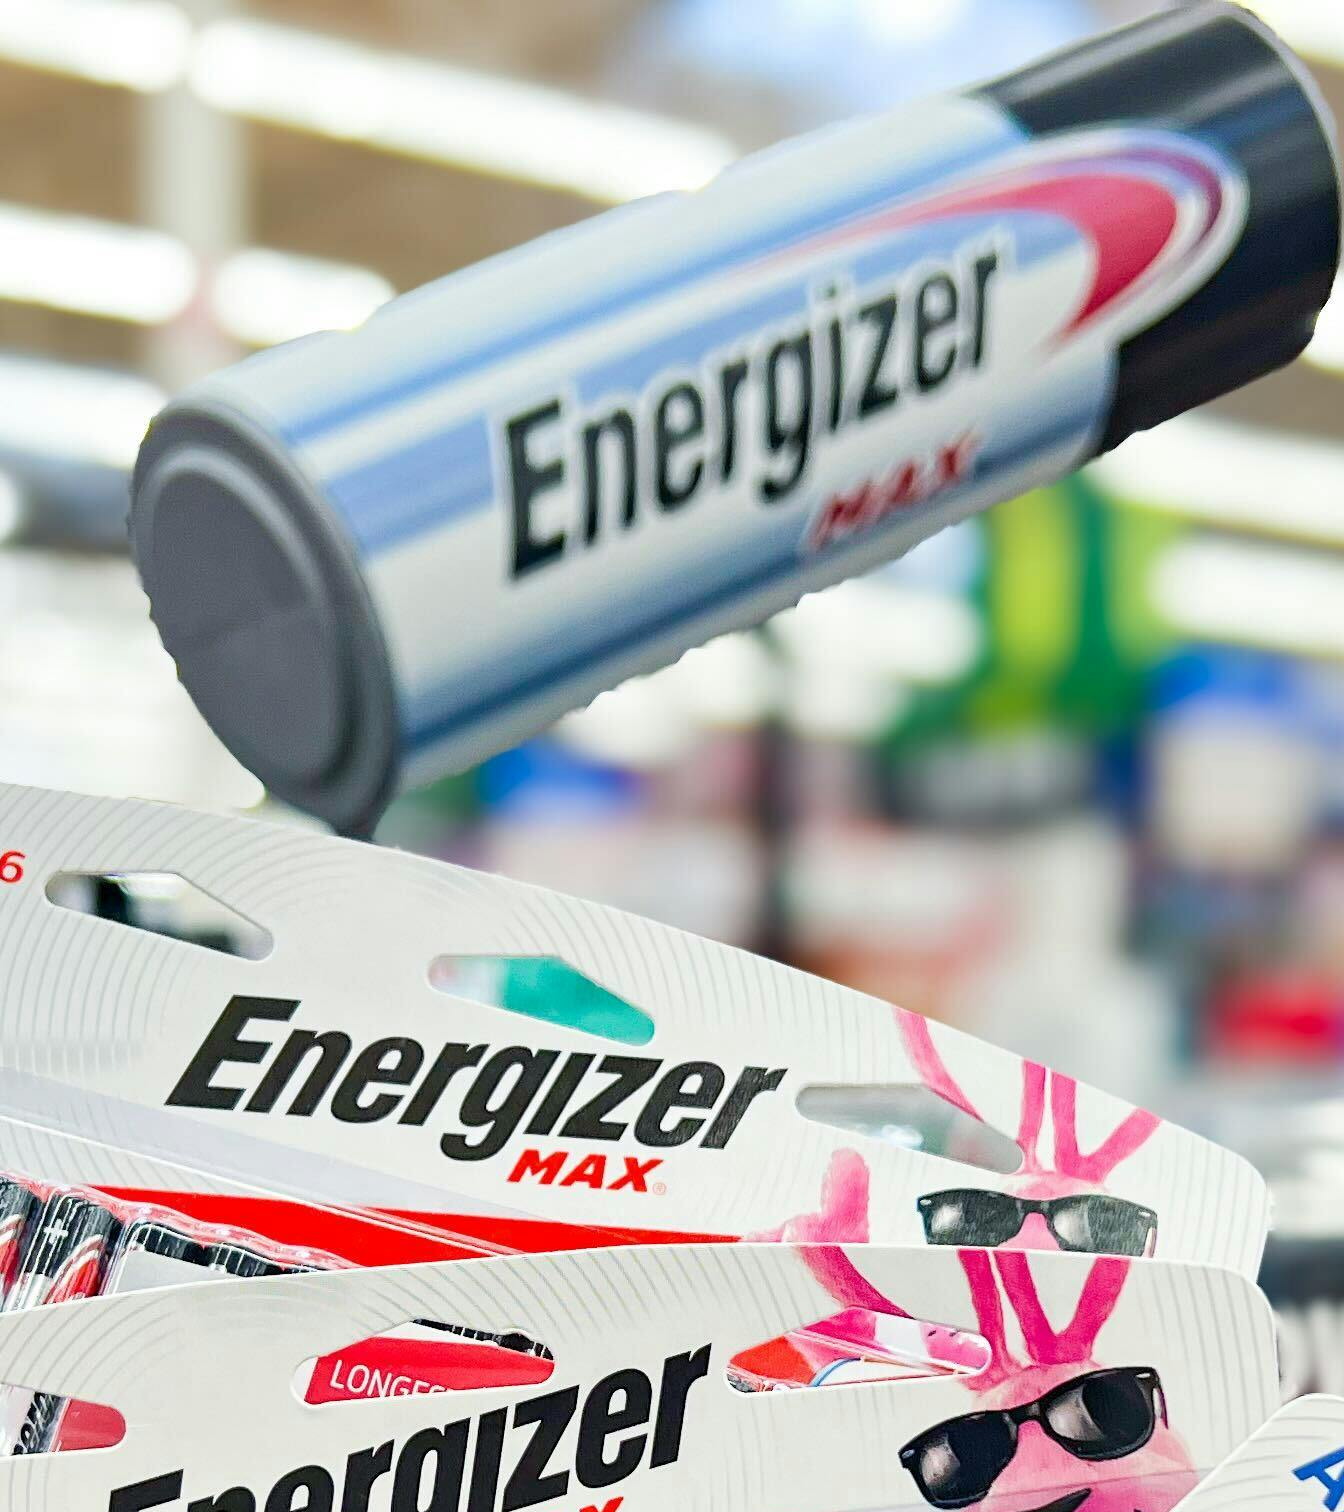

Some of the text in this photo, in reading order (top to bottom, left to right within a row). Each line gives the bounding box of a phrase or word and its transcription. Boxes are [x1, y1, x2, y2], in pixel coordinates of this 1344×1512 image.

[503, 247, 1001, 579] Energizer
[812, 433, 979, 550] MAX
[165, 994, 788, 1161] Energizer
[507, 1148, 664, 1194] MAX
